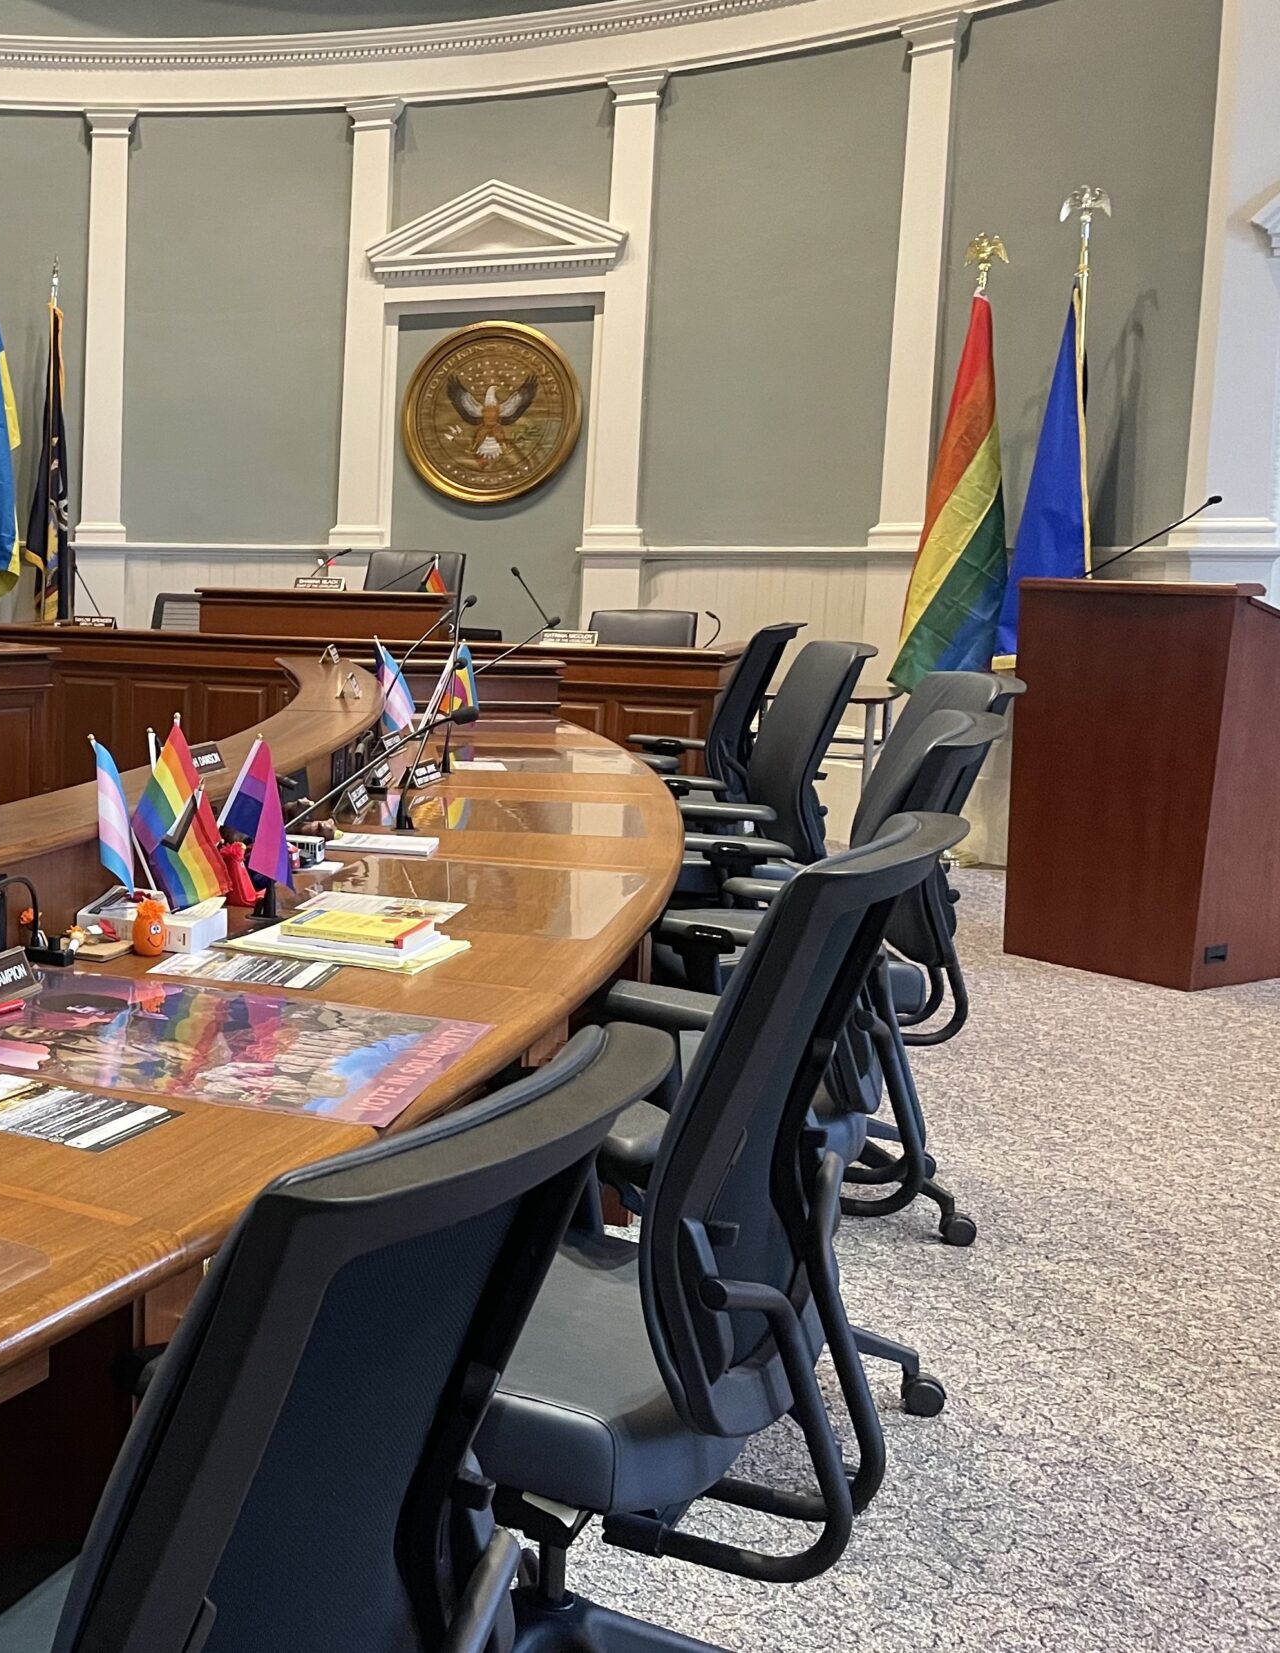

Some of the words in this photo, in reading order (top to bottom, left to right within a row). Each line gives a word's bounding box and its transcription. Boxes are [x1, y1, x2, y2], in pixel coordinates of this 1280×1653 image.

[425, 343, 498, 400] TOMPKINS
[508, 343, 561, 397] COUNTY
[399, 1026, 472, 1075] SOLIDARITY
[352, 1085, 407, 1111] VOTE
[384, 1074, 419, 1086] IN
